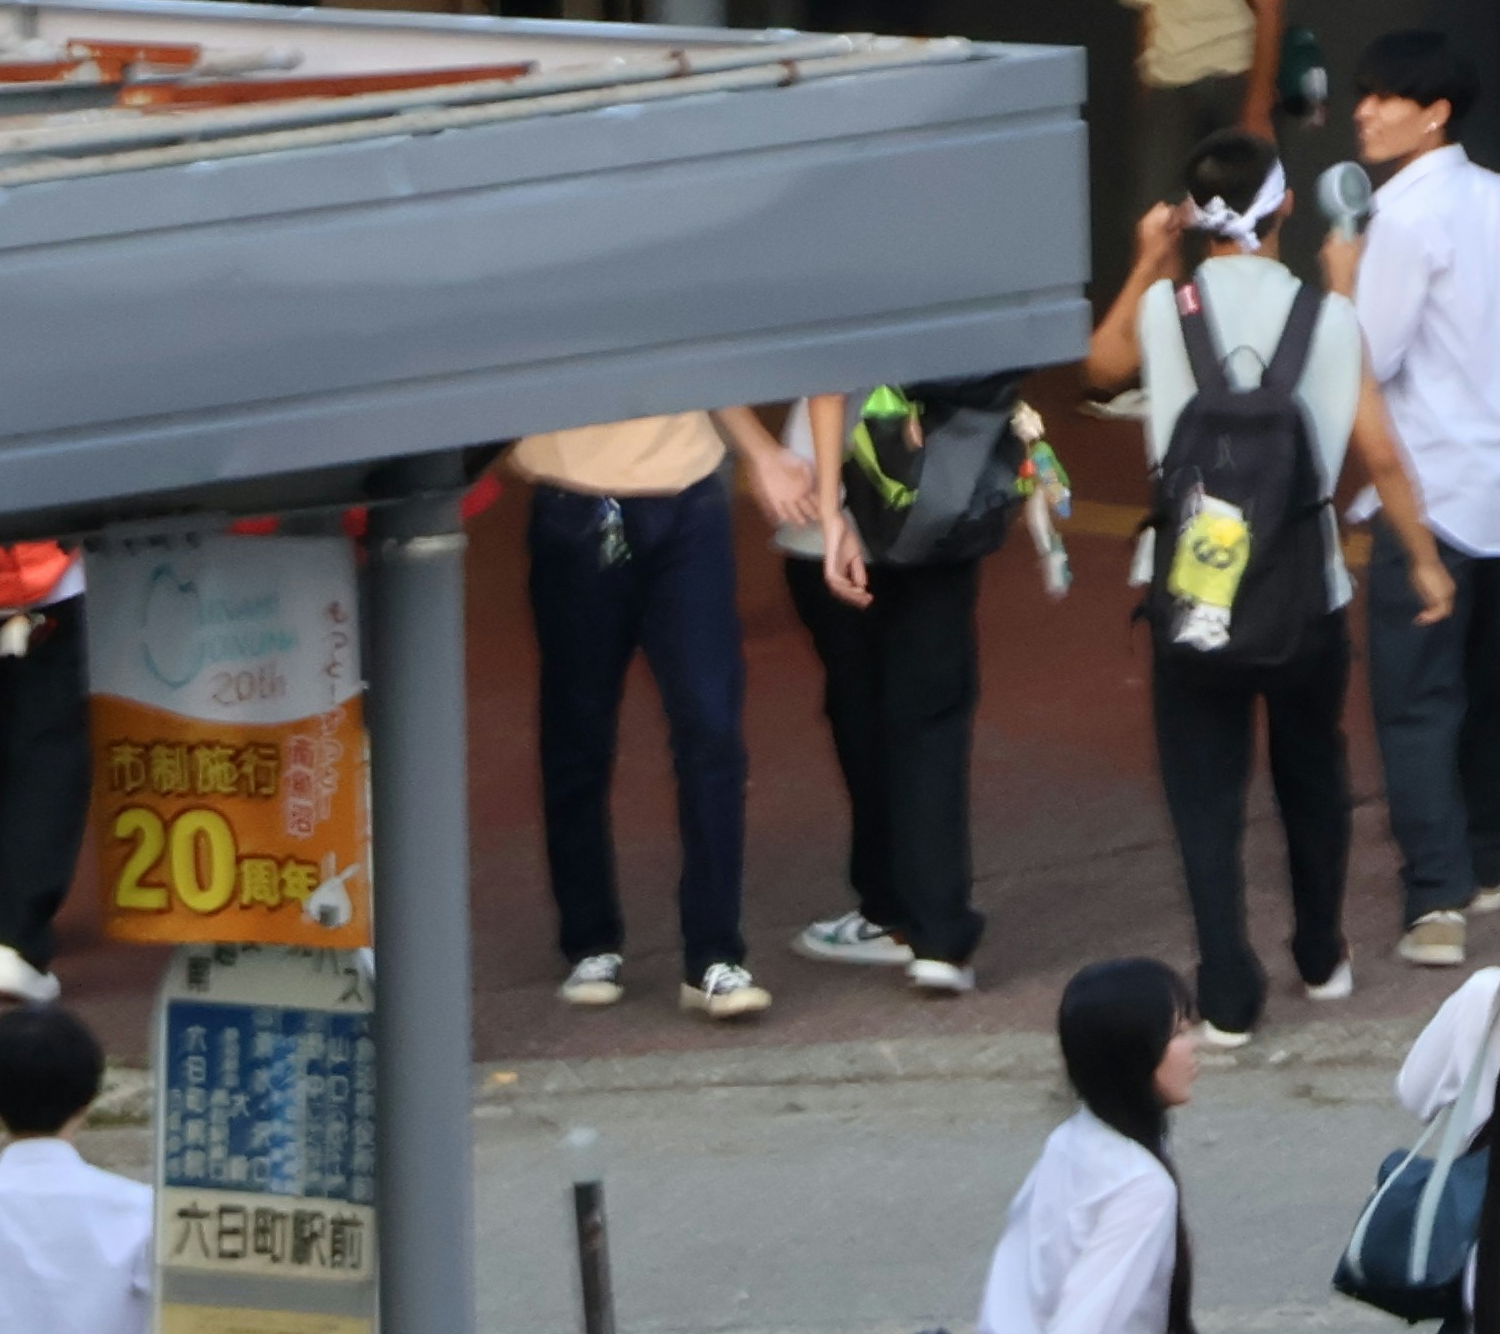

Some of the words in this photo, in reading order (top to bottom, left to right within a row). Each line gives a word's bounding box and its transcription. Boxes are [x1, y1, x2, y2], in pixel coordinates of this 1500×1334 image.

[110, 742, 282, 796] 市制施行
[114, 808, 320, 914] 20周年
[173, 1200, 366, 1269] 六日町駅前
